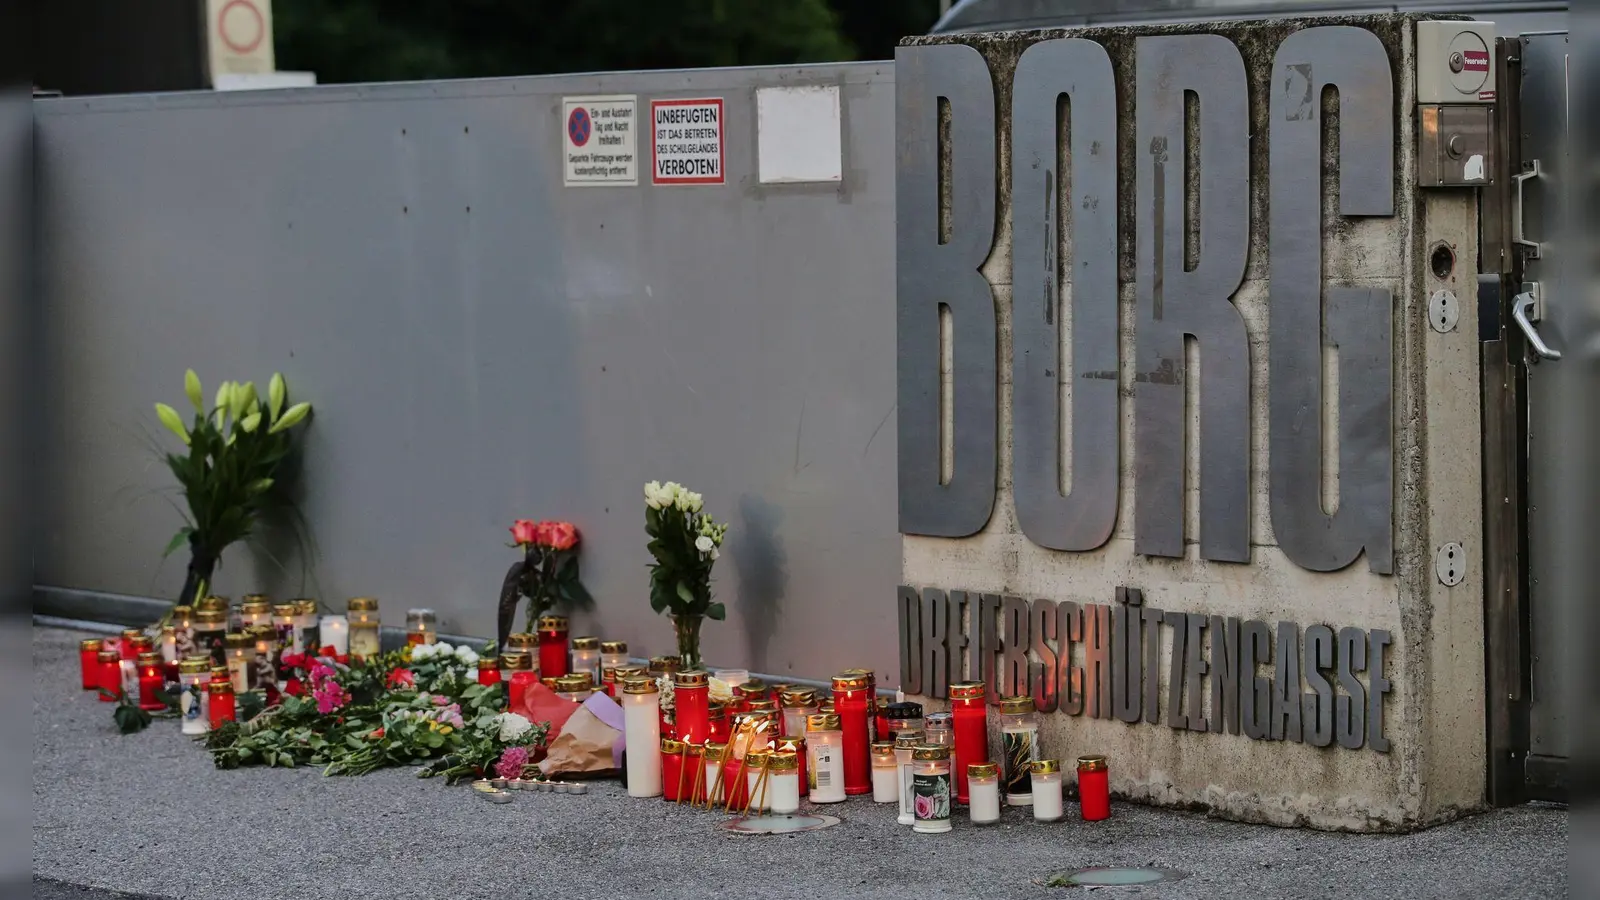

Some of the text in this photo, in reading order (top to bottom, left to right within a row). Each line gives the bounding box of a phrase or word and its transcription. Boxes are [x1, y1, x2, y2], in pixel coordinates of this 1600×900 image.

[1464, 57, 1488, 65] Feuerwehr
[601, 109, 611, 118] und
[656, 108, 717, 124] UNBEFUGTEN
[594, 121, 603, 134] Tag
[604, 121, 613, 131] und
[657, 128, 717, 139] IST DAS BETRETEN
[657, 144, 668, 154] DES
[658, 158, 718, 175] VERBOTEN!
[895, 26, 1394, 575] BORG
[897, 585, 1391, 753] DREIERSCHÜTZENGASSE
